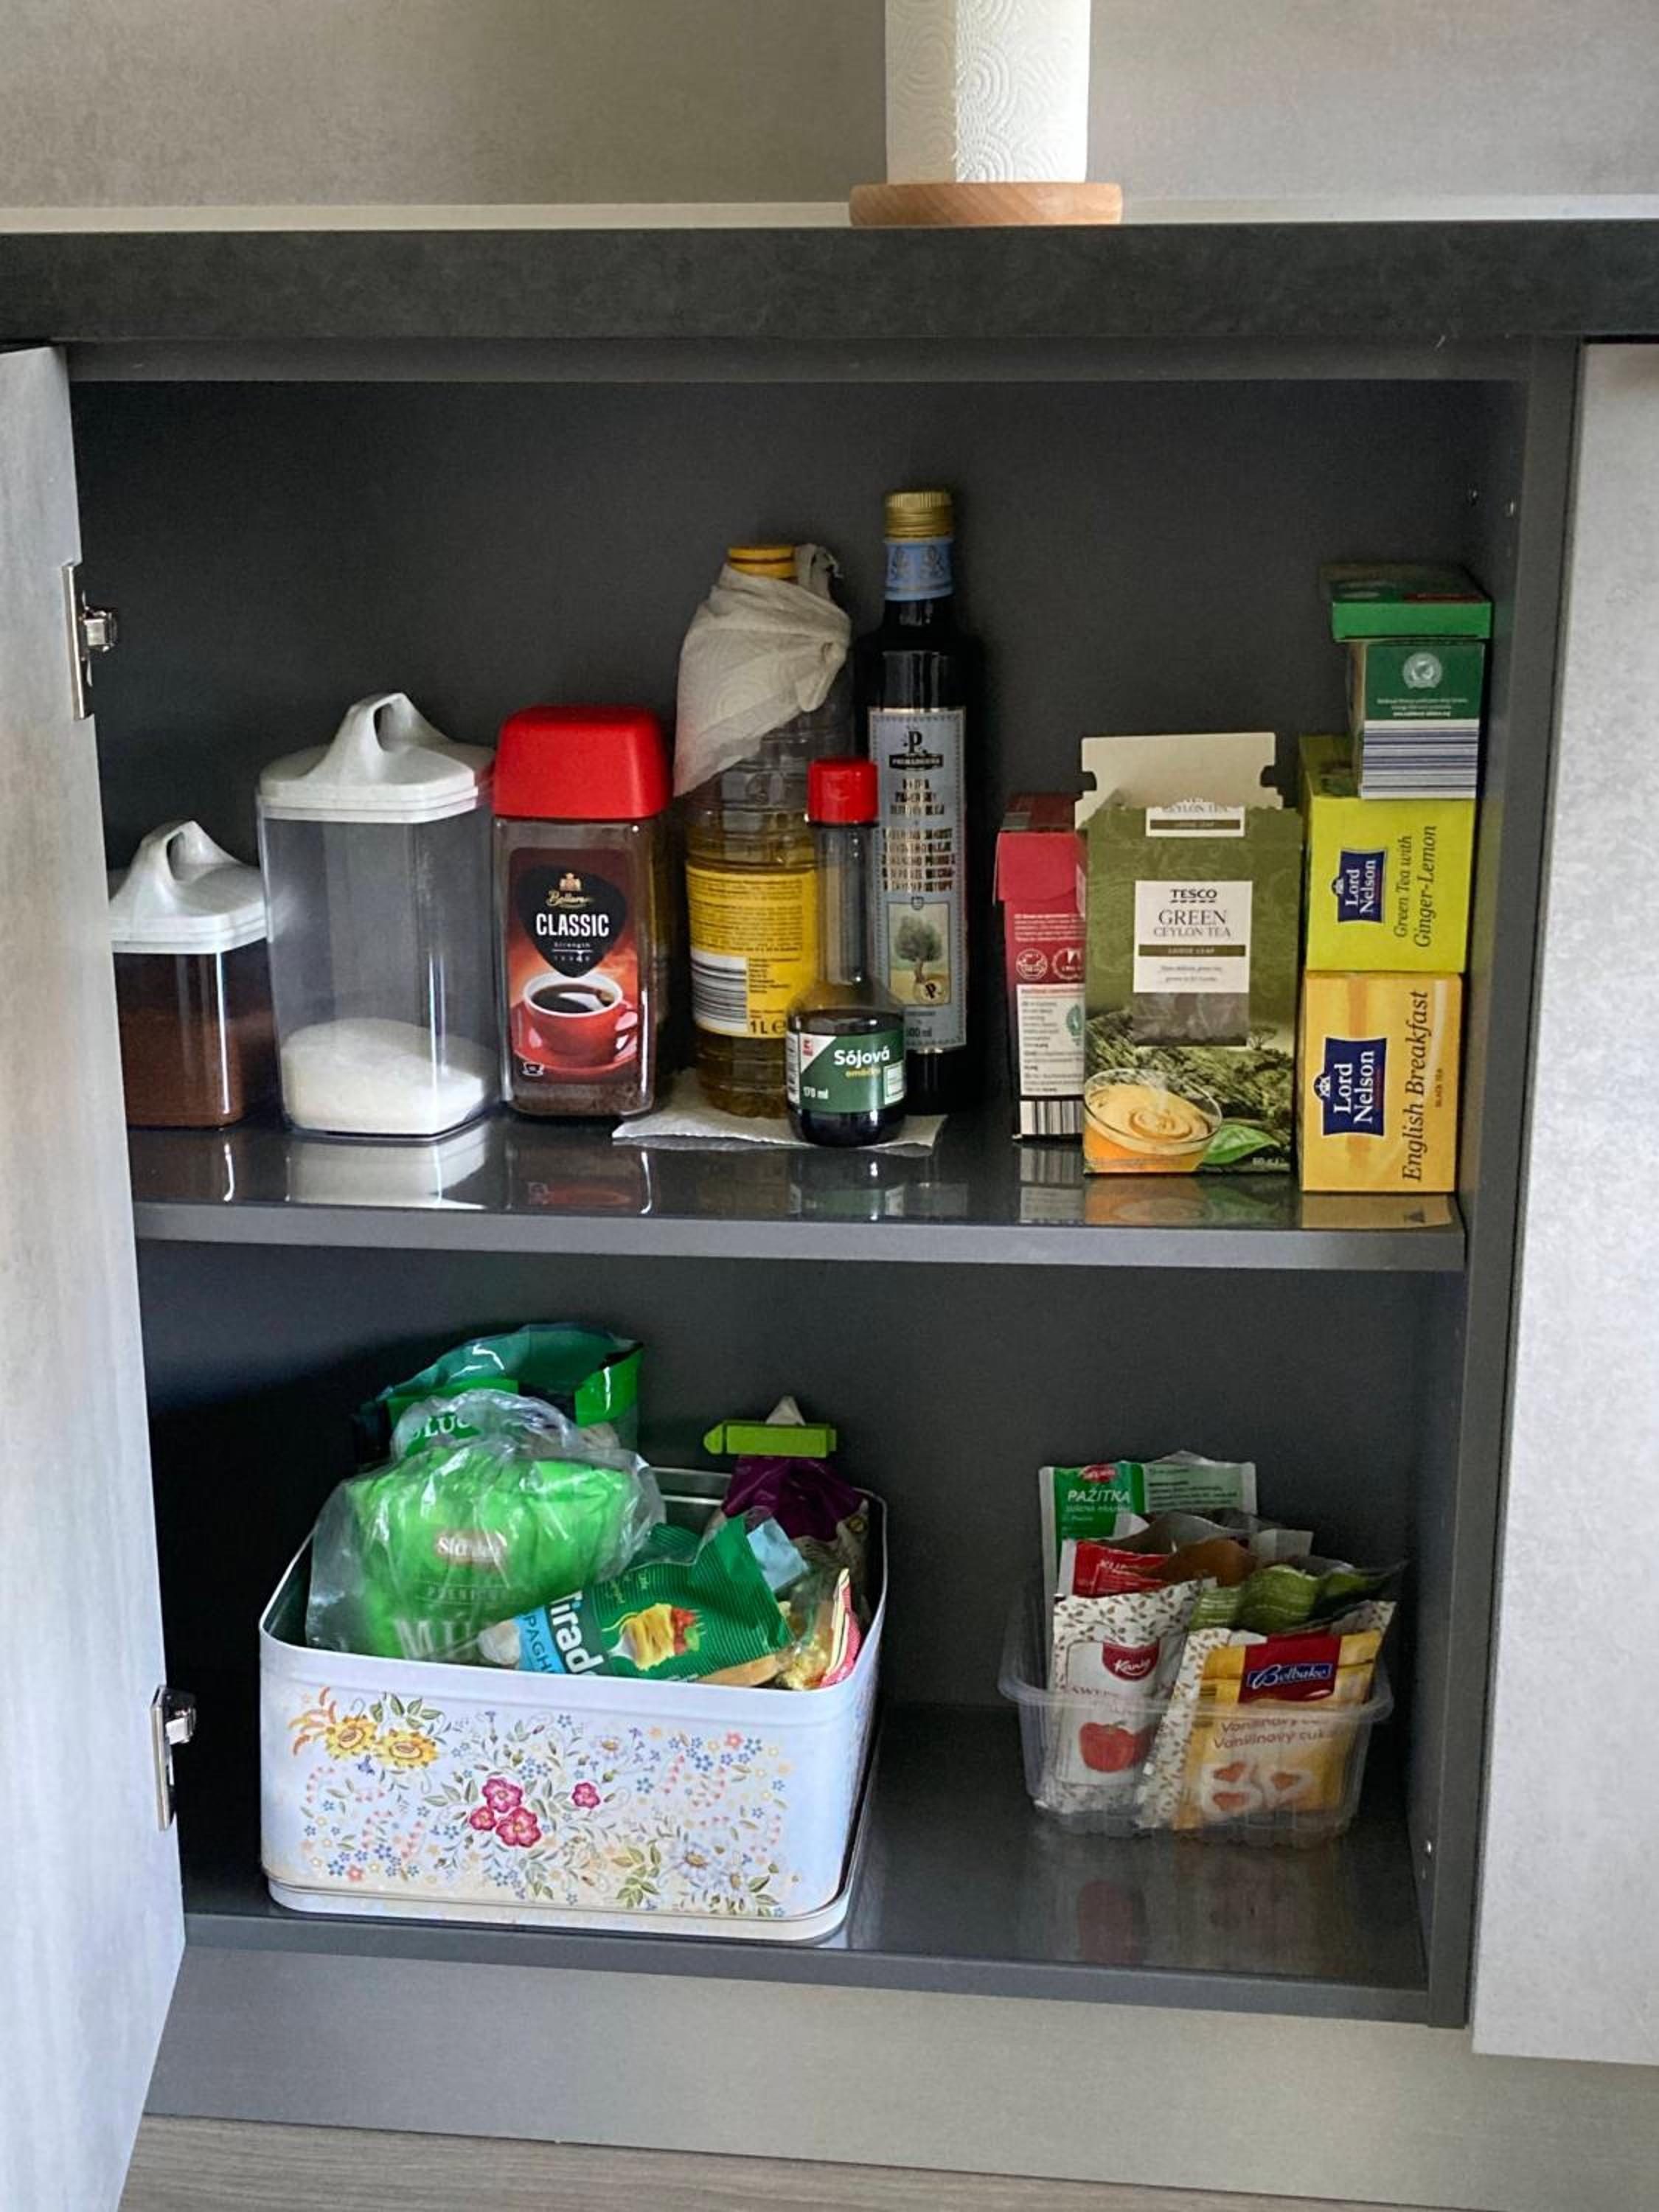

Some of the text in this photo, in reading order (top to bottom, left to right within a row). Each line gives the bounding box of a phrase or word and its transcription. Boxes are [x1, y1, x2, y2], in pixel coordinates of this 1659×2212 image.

[1170, 888, 1217, 899] TESCO
[1345, 868, 1360, 907] Lord
[1359, 860, 1377, 914] Nelson
[1394, 835, 1412, 938] Green Tea with
[1413, 825, 1437, 947] Ginger-Lemon
[536, 913, 610, 937] CLASSIC
[1153, 927, 1231, 939] CEYLON TEA
[1158, 909, 1227, 925] GREEN
[834, 1047, 890, 1068] Sójová
[1333, 1062, 1353, 1114] Lord
[1354, 1050, 1375, 1124] Nelson
[1402, 990, 1433, 1183] English Breakfast
[1067, 1486, 1131, 1503] PAŽÍTKA
